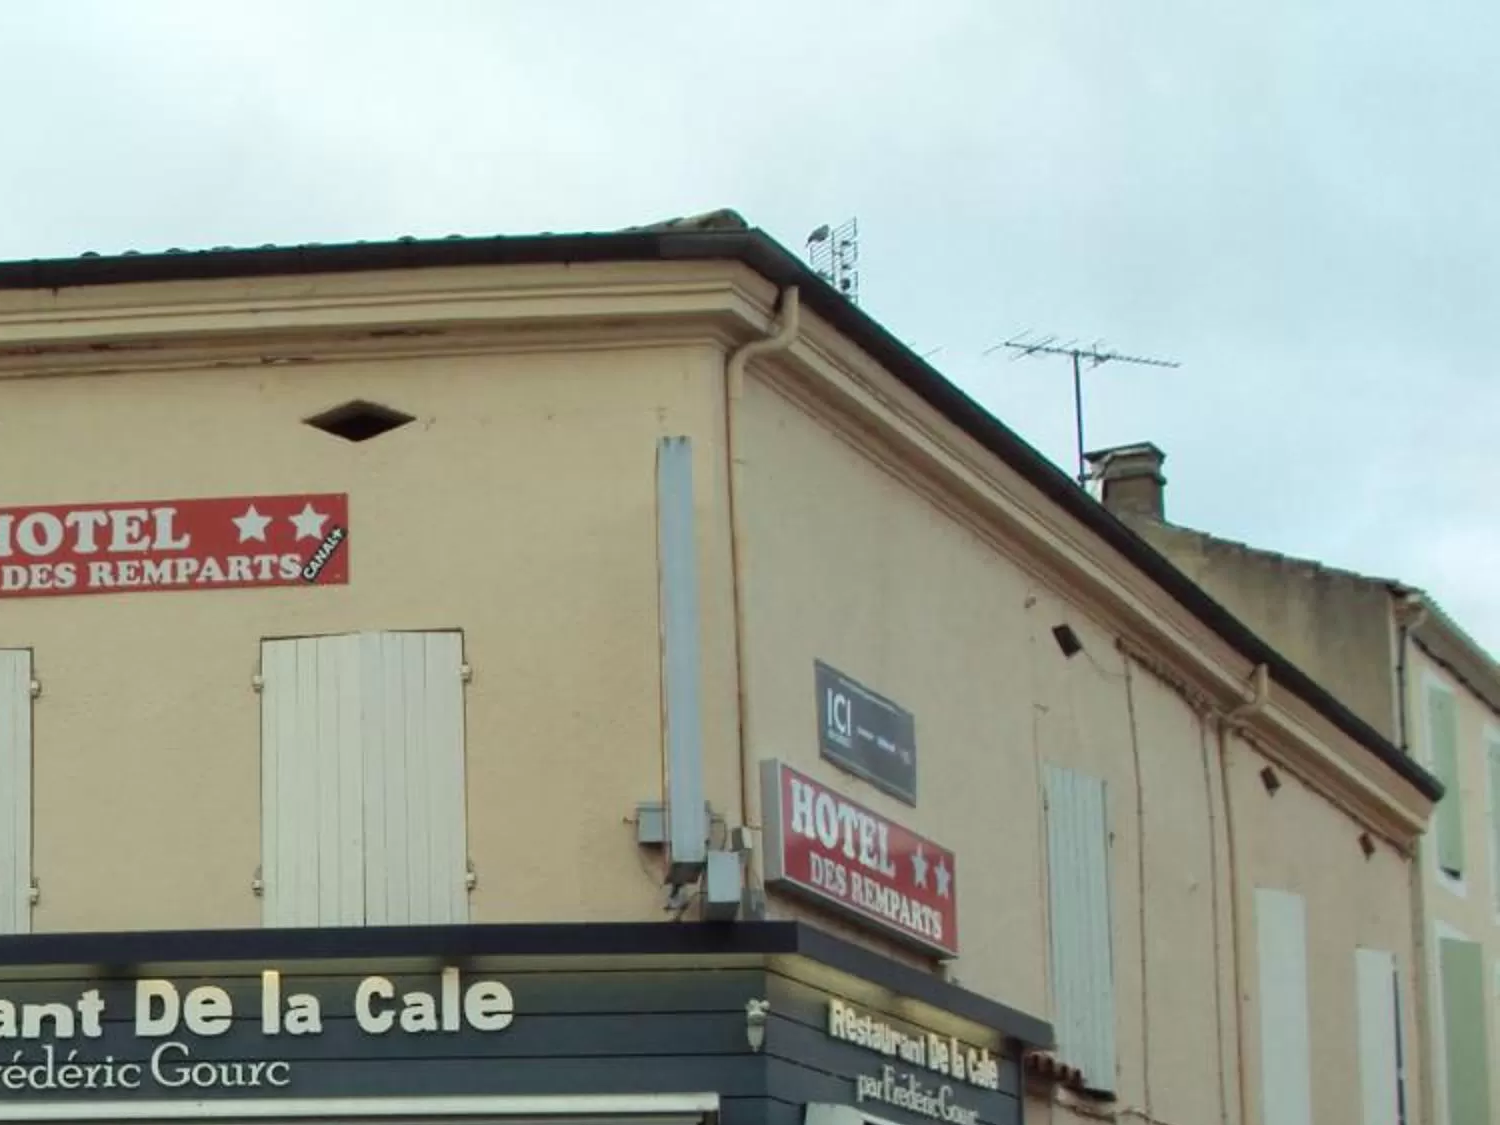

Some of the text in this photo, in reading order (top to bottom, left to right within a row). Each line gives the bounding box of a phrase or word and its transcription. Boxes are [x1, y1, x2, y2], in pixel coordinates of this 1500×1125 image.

[0, 555, 303, 591] DES REMPARTS
[826, 687, 852, 737] ICI
[790, 778, 896, 878] HOTEL
[809, 852, 942, 940] DES REMPARTS
[135, 978, 233, 1037] De
[261, 969, 323, 1035] la
[355, 966, 514, 1034] Cale
[829, 998, 925, 1067] Restaurant
[152, 1042, 290, 1088] Gourc
